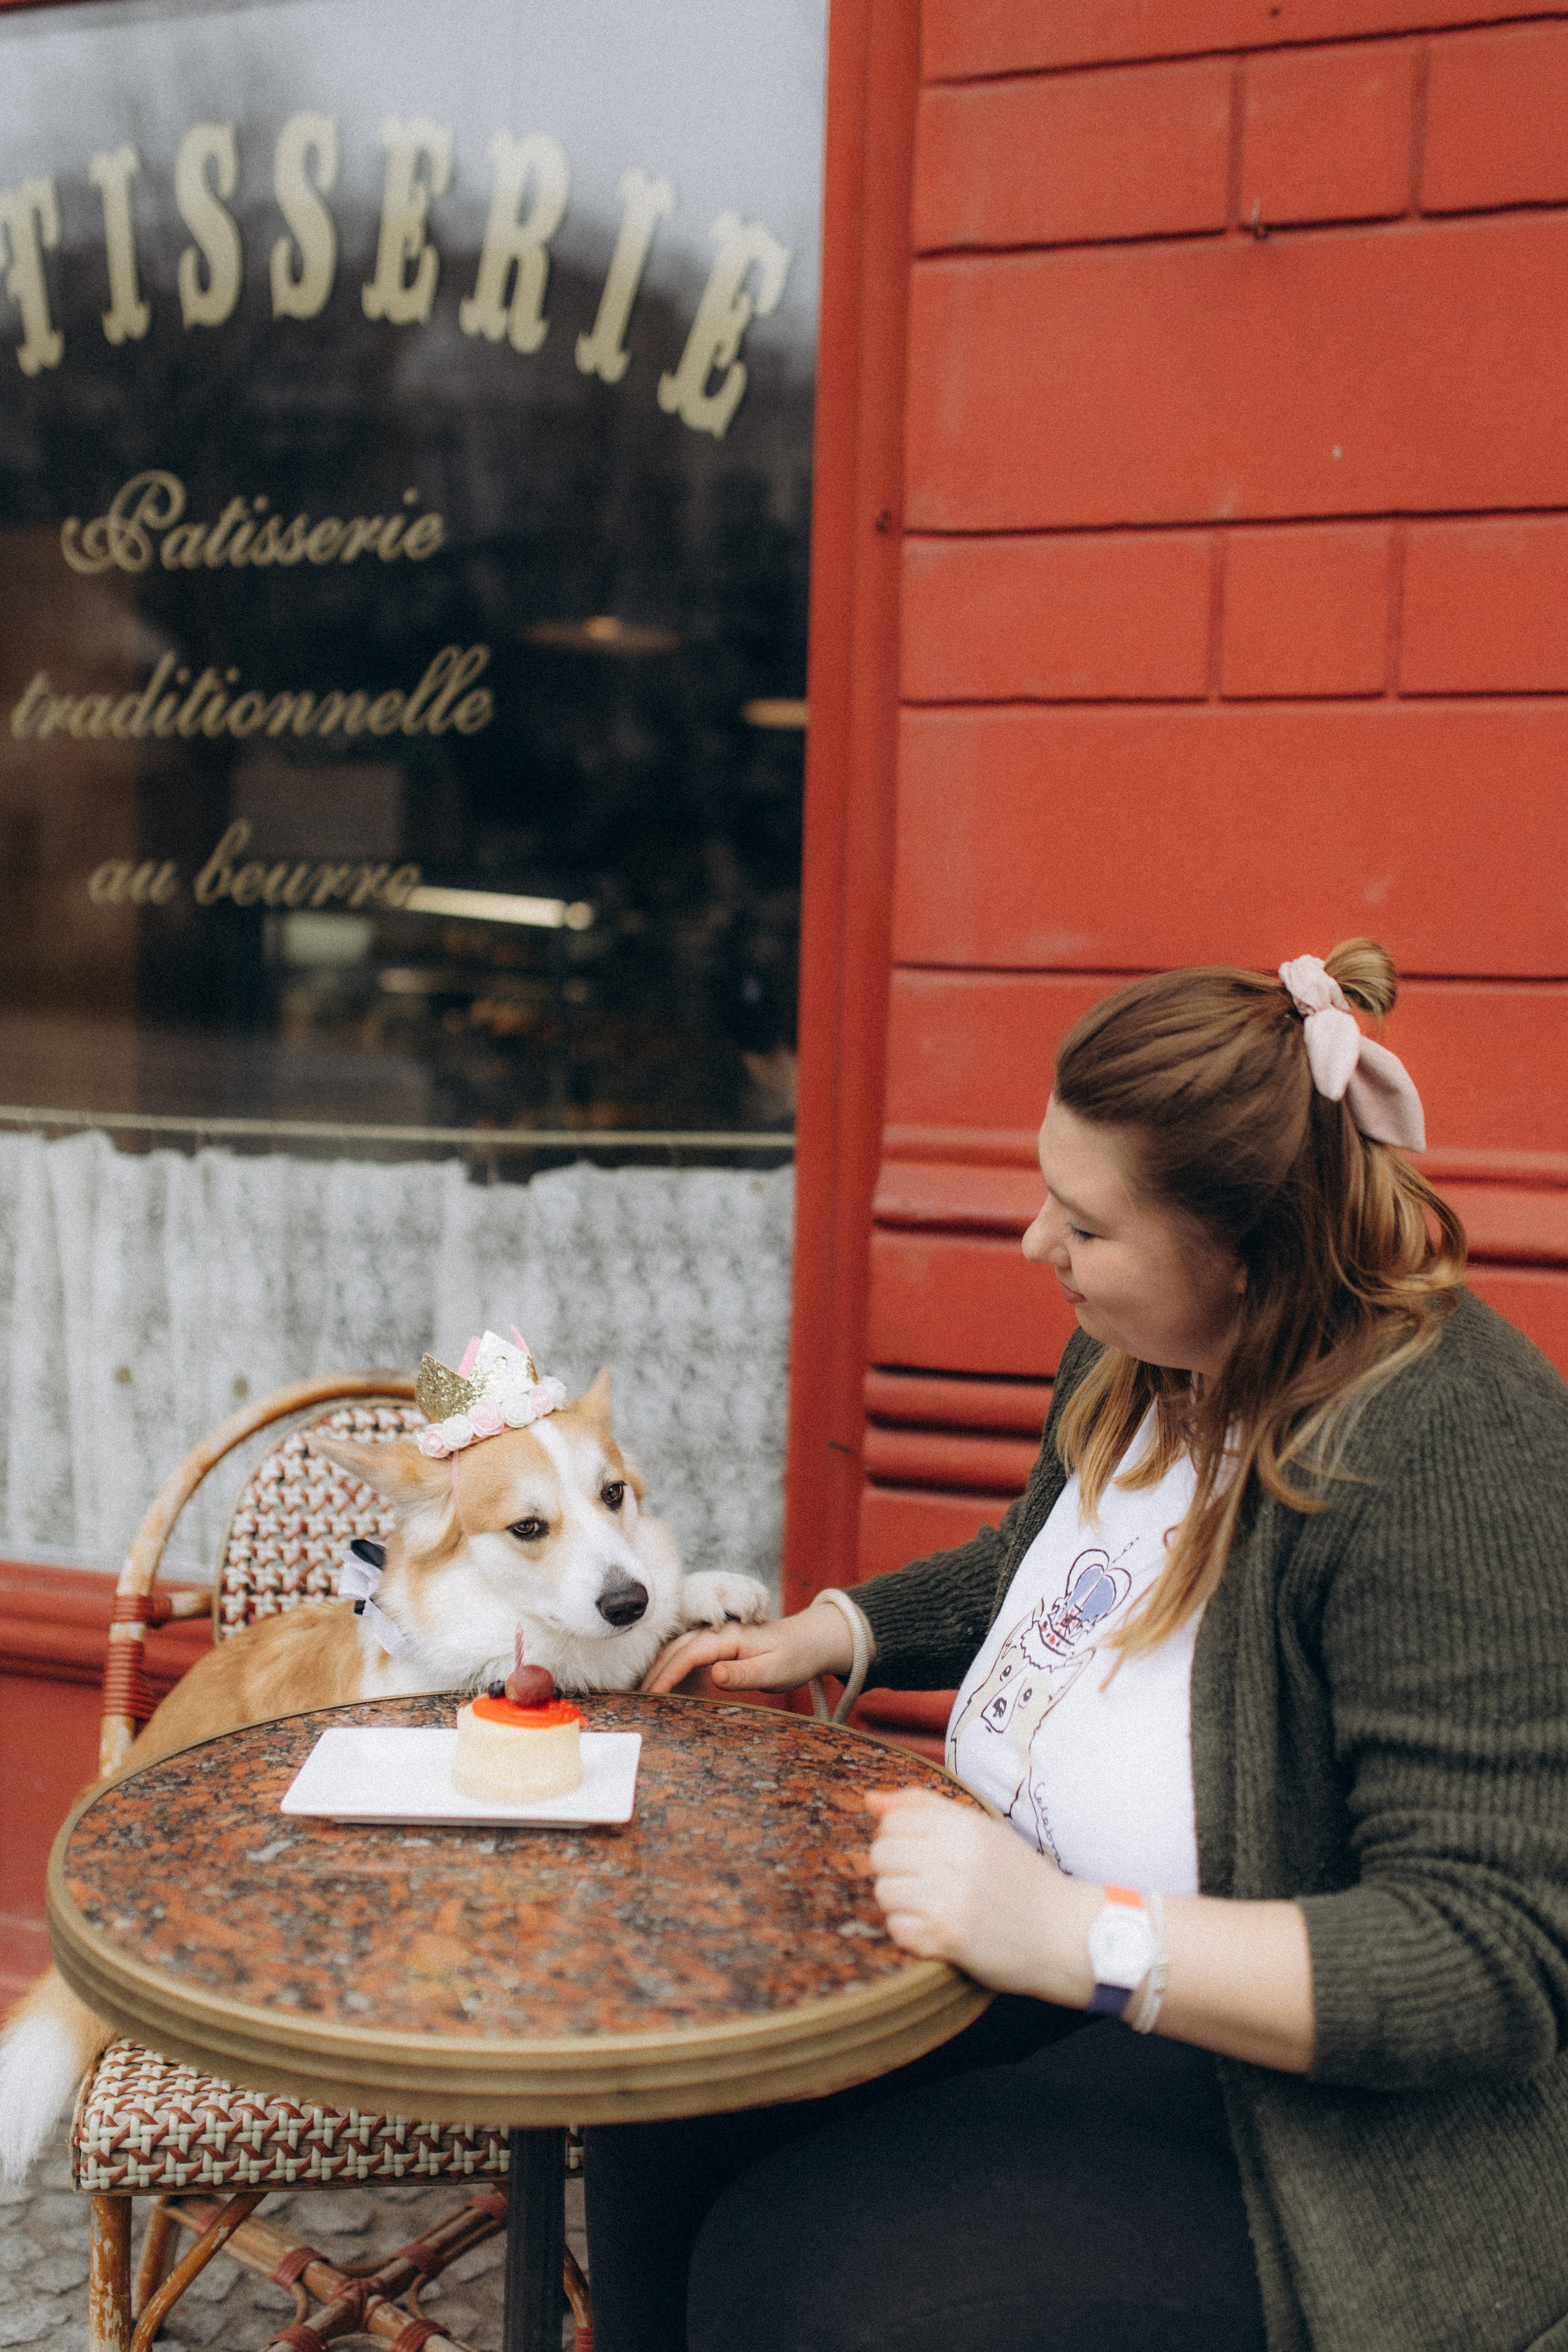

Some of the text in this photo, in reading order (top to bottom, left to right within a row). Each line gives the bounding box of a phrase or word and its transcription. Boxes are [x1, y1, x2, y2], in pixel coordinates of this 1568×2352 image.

[0, 110, 793, 439] TISSERIE
[60, 470, 443, 575] Patisserie
[10, 644, 492, 739] traditionnelle
[87, 818, 423, 907] au beurre
